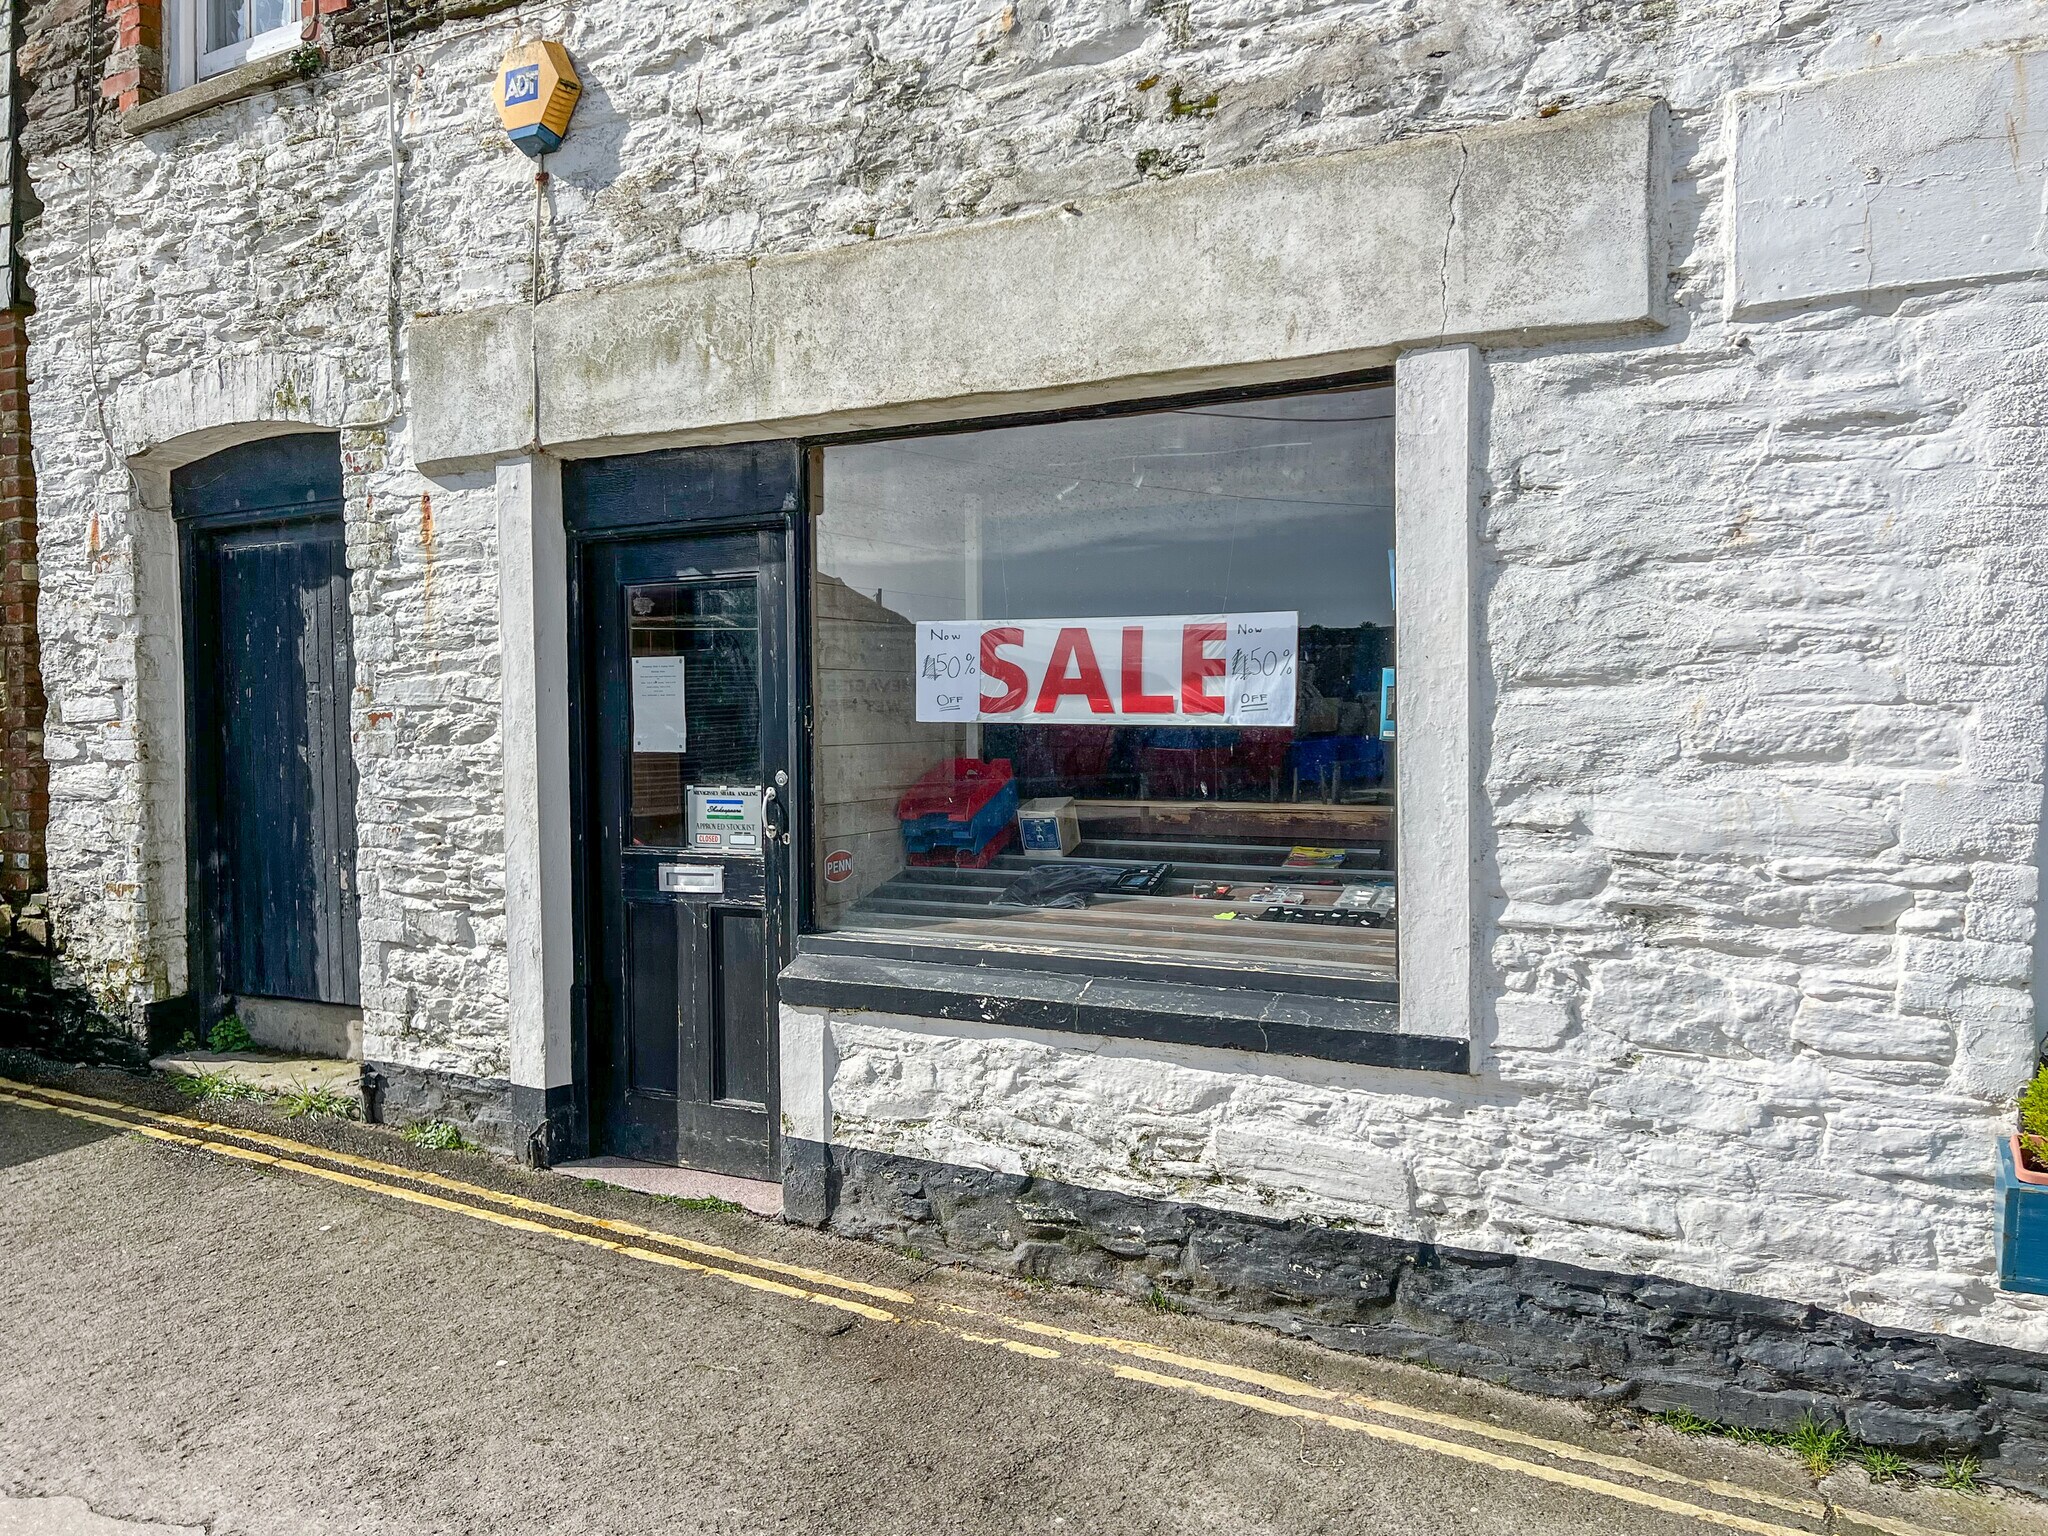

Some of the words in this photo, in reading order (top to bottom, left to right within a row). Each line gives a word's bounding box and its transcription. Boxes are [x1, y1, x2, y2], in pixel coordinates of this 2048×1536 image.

[504, 70, 538, 101] ADT
[979, 622, 1227, 714] SALE
[936, 694, 963, 706] OFF
[1240, 693, 1268, 704] OFF
[696, 822, 726, 831] APPROVED
[726, 823, 755, 831] STOCKIST
[698, 835, 719, 843] CLOSED
[827, 858, 852, 876] PENN
